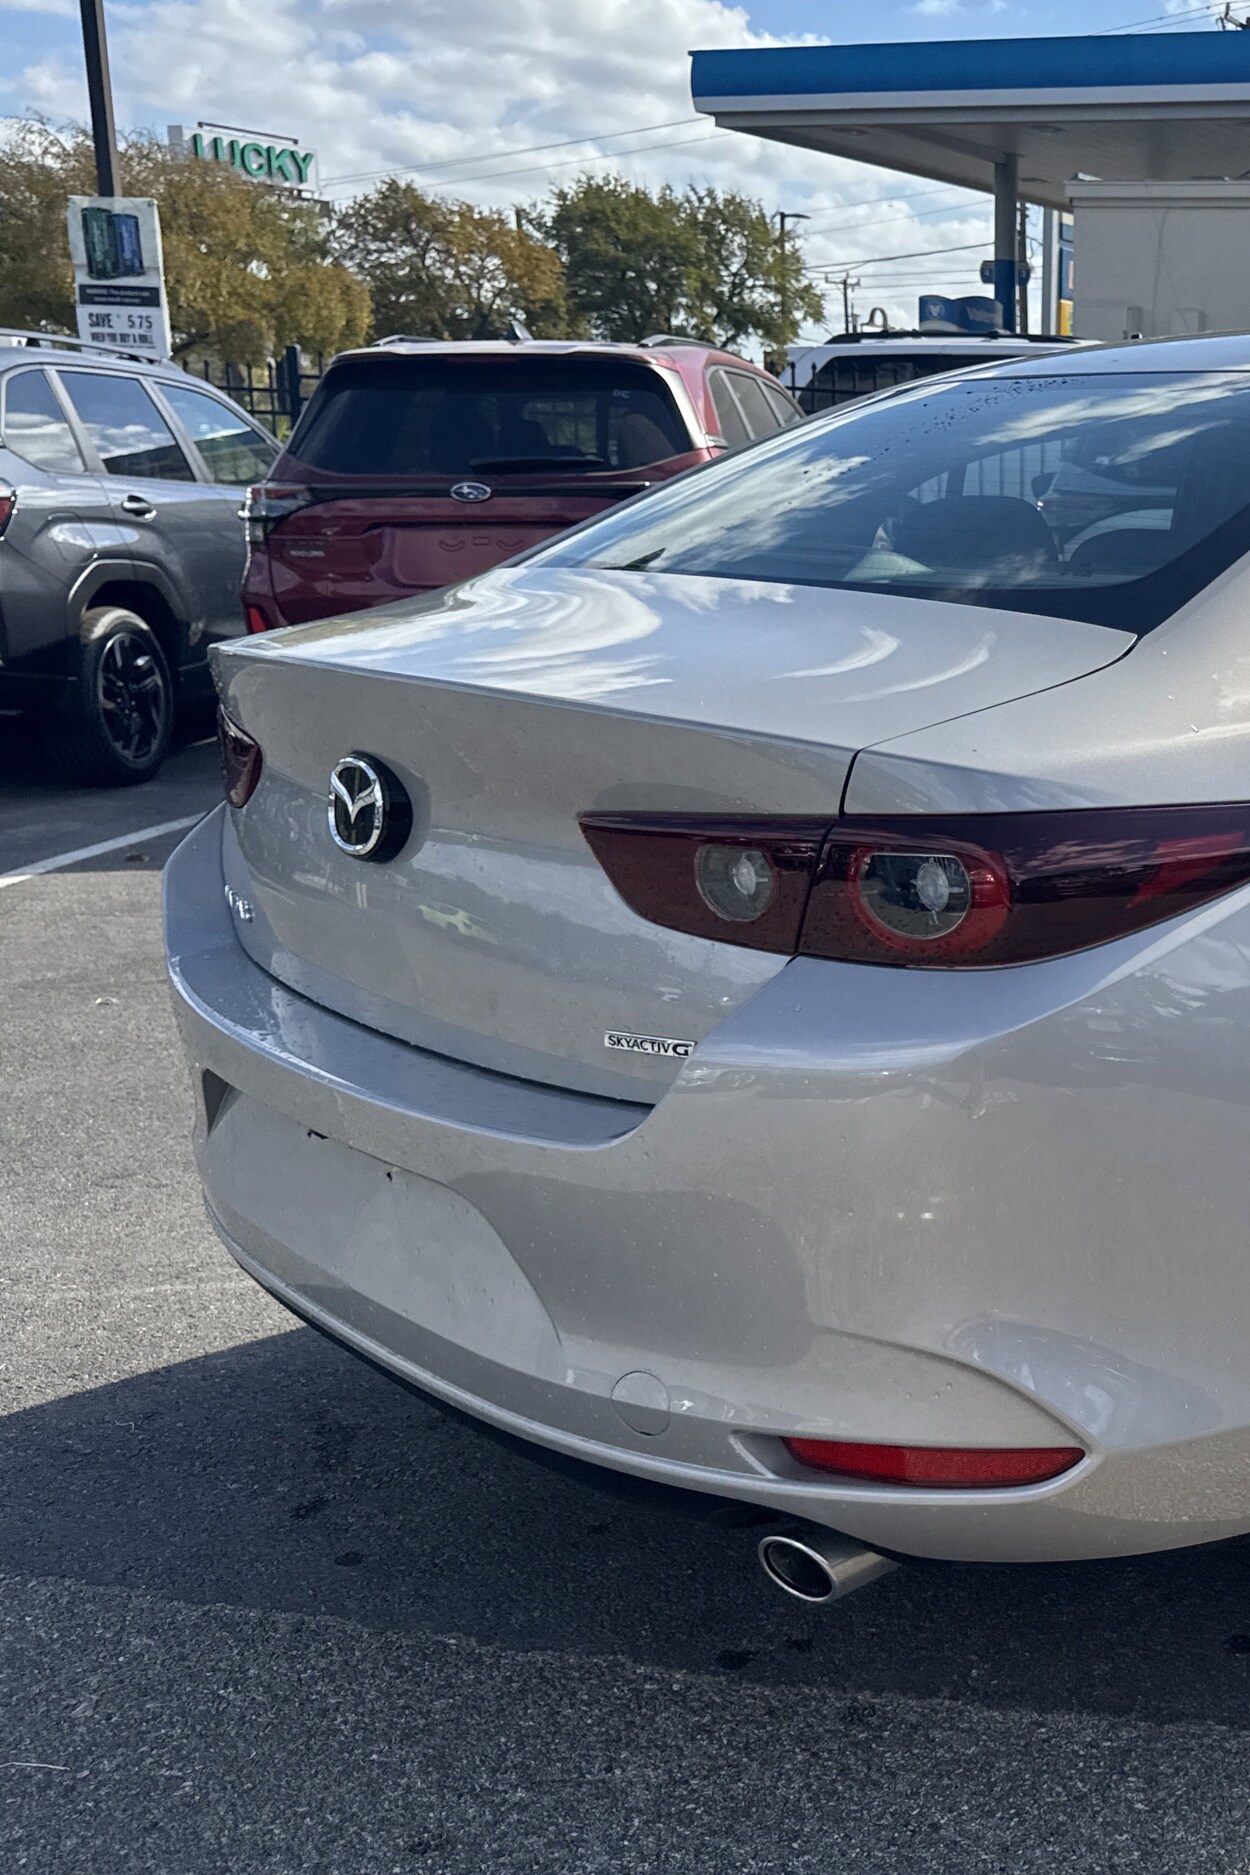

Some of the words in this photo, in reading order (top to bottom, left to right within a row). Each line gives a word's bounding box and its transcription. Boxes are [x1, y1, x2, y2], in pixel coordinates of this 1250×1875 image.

[193, 133, 313, 183] LUCKY
[88, 312, 113, 329] SAVE
[608, 1035, 671, 1053] SKYACTIV
[671, 1043, 690, 1057] G
